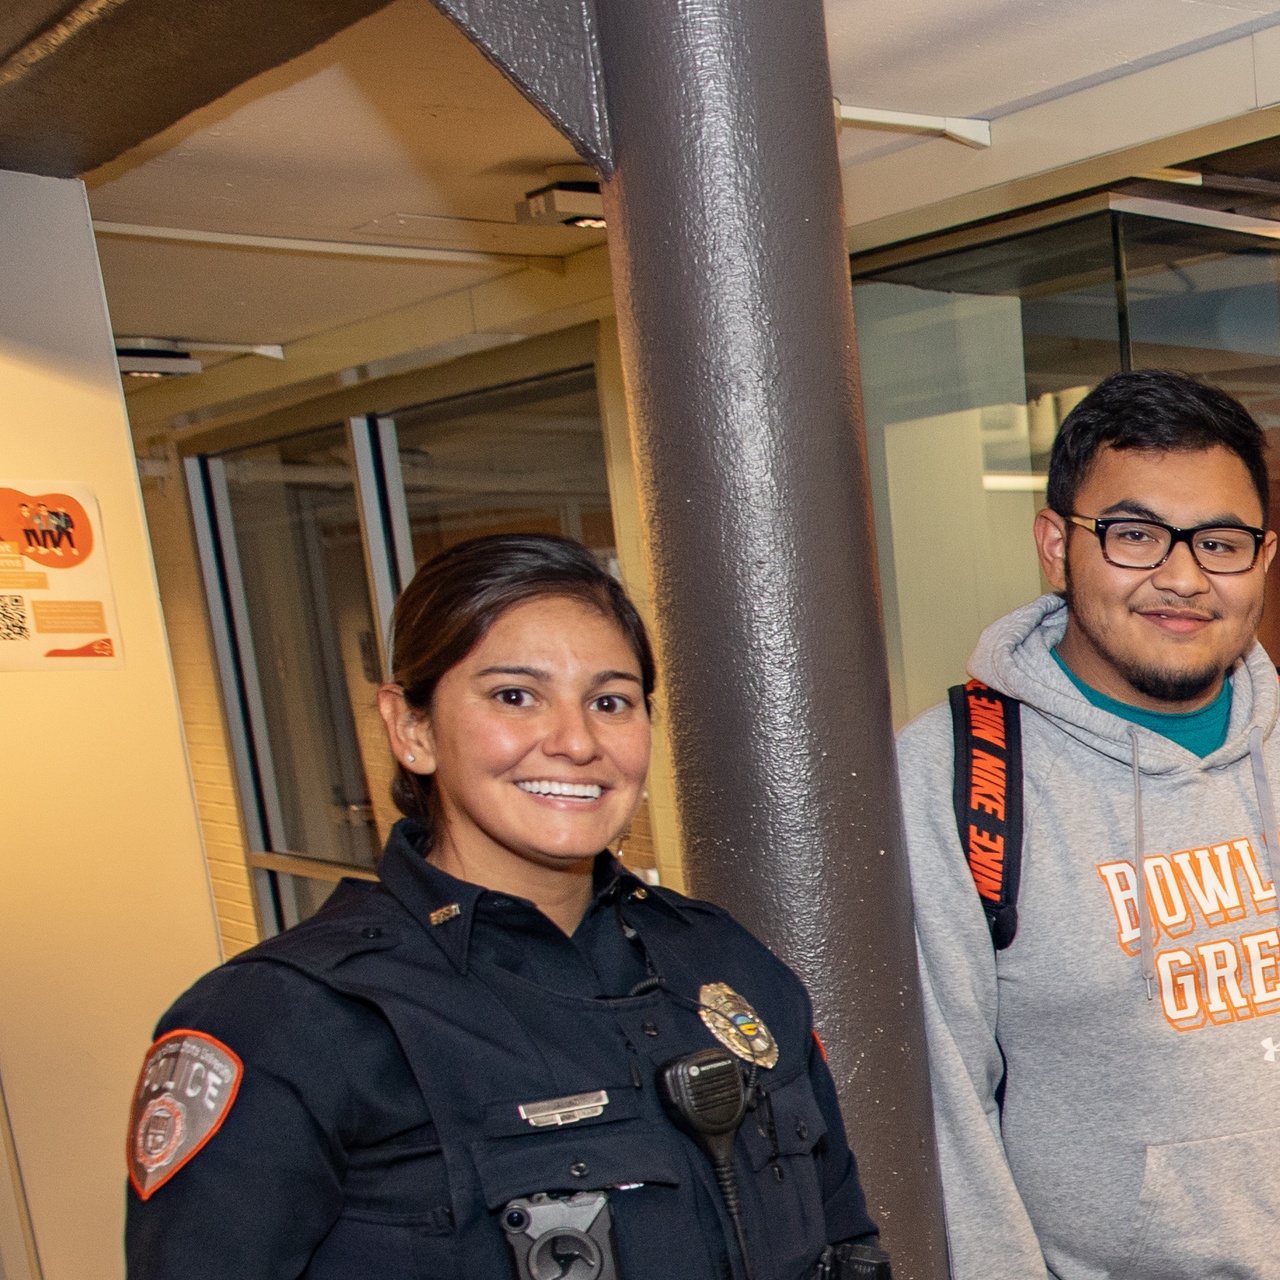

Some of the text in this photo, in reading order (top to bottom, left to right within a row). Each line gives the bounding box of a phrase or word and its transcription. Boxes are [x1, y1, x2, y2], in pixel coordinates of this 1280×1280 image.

[967, 694, 1007, 750] NIKE
[970, 747, 1007, 822] NIKE
[968, 824, 1004, 902] NIKE
